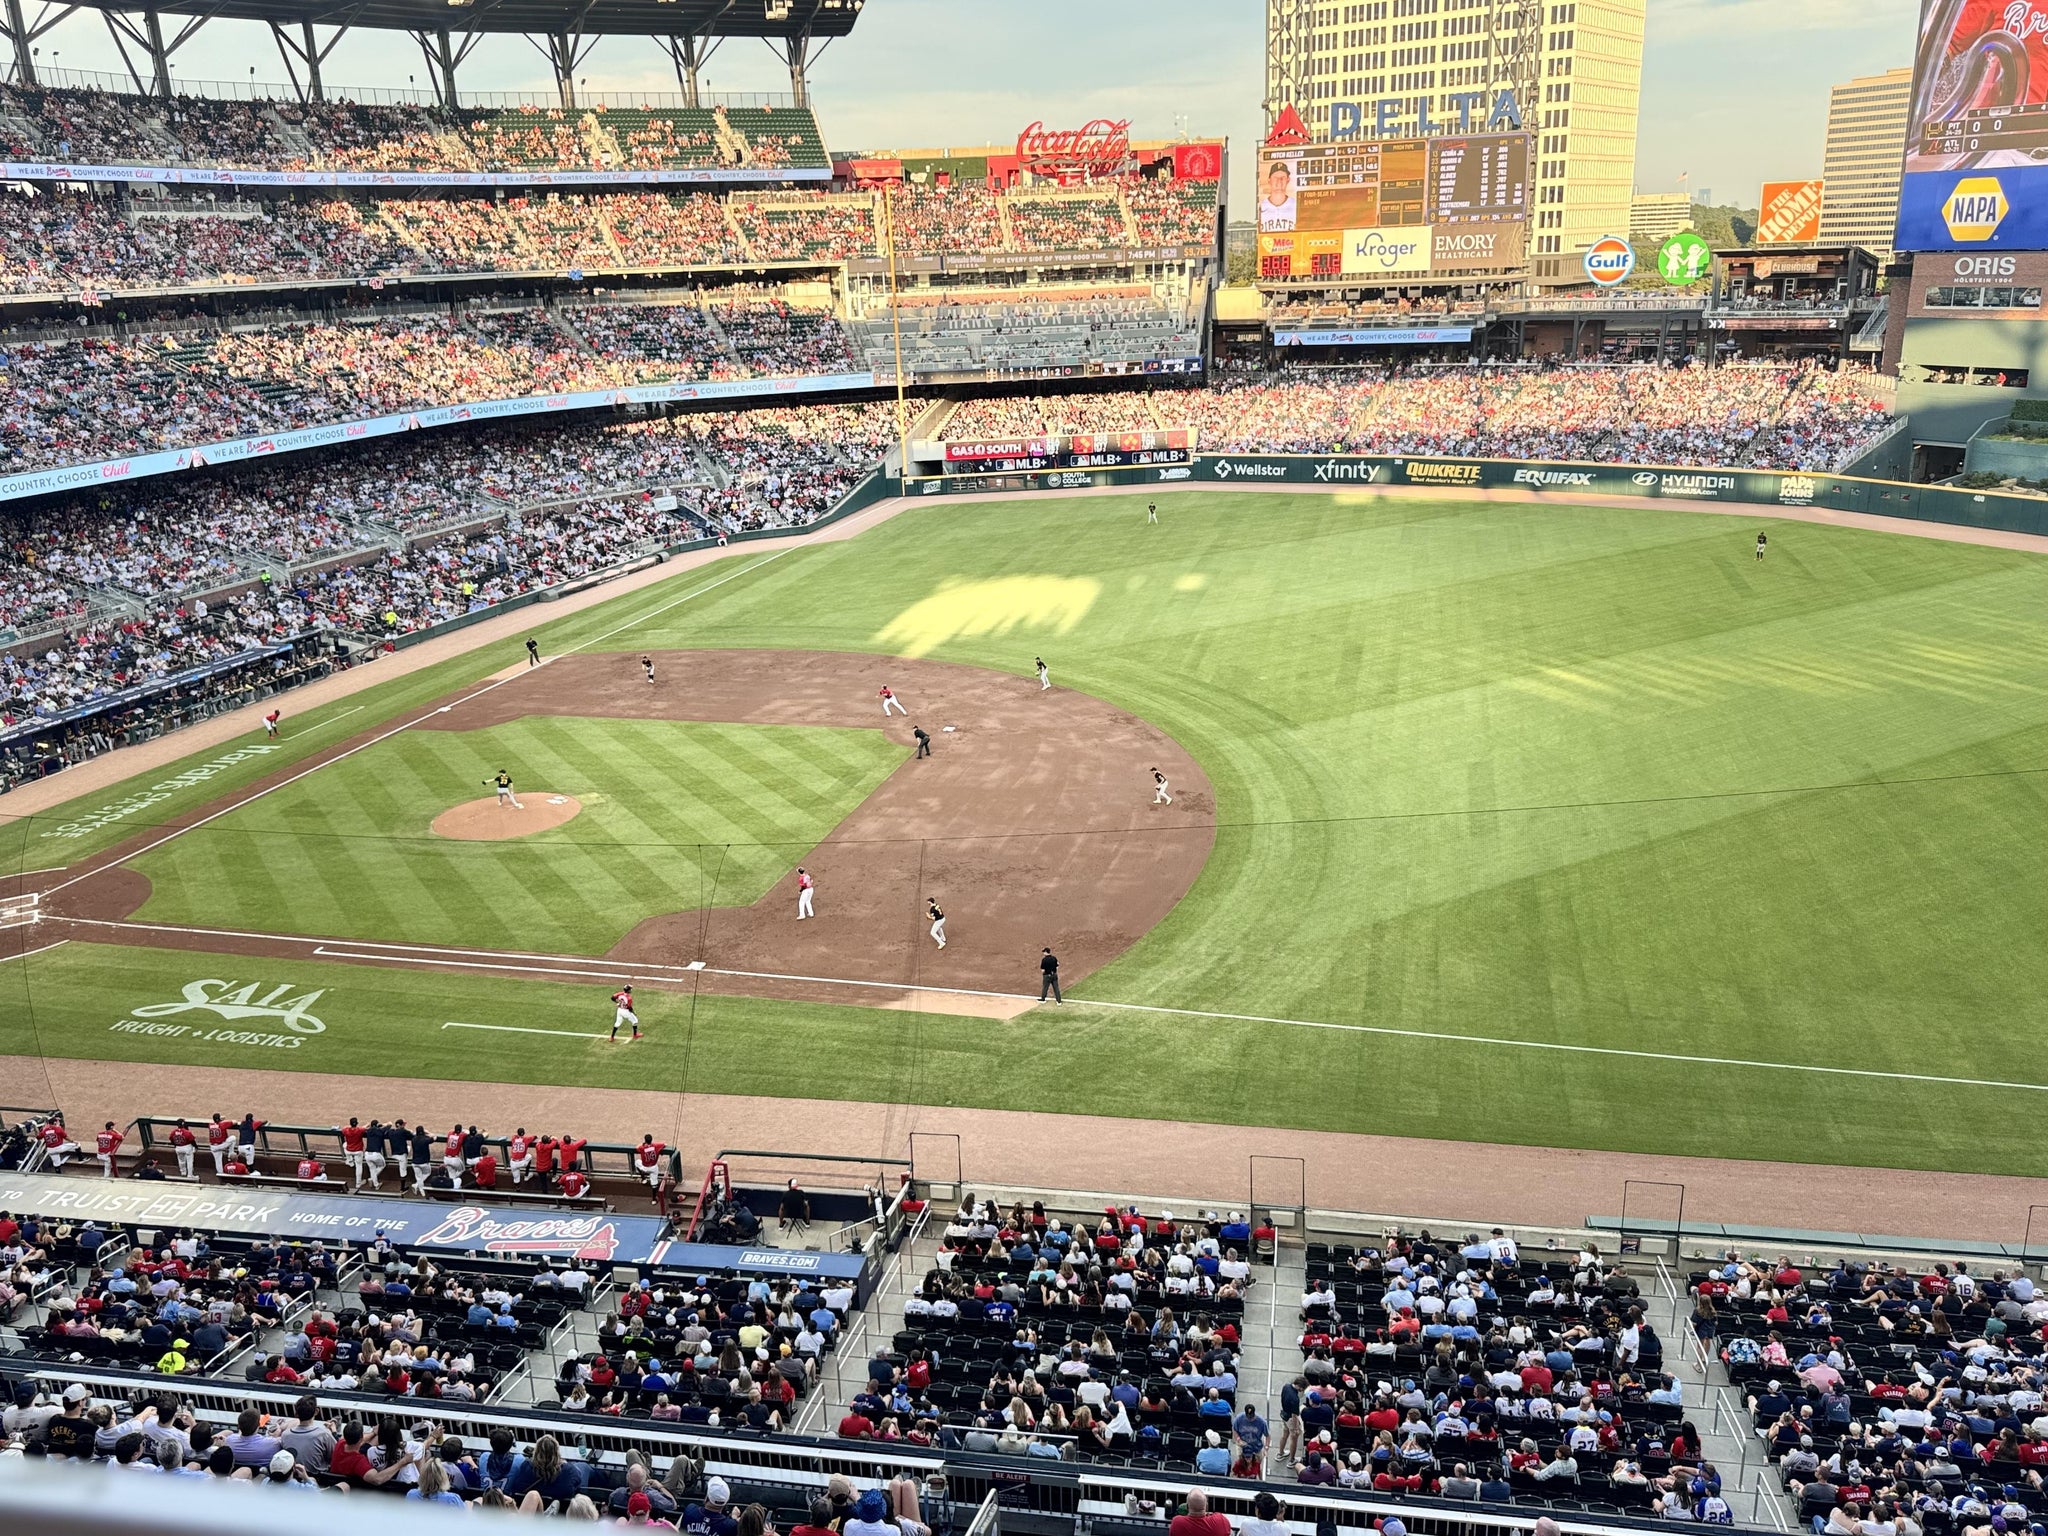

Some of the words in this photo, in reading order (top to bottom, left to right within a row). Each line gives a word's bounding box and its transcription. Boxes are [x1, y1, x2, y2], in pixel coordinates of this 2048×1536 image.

[1330, 90, 1522, 137] DELTA
[1972, 121, 1980, 132] 0
[1994, 120, 2001, 131] 0
[1016, 119, 1133, 163] Coca-Cola
[1970, 139, 1978, 149] 0
[135, 170, 153, 178] Chill
[287, 174, 306, 183] Chill
[453, 175, 470, 183] Chill
[612, 173, 630, 181] Chill
[1766, 188, 1793, 213] THE
[1759, 181, 1822, 241] HOME
[1952, 196, 1997, 223] NAPA
[1781, 202, 1820, 241] DEPOT
[1435, 233, 1498, 251] EMORY
[1356, 232, 1417, 267] Kroger
[1435, 250, 1494, 260] HEALTHCARE
[1072, 253, 1090, 261] GOOD
[1262, 256, 1290, 269] 368
[1588, 254, 1629, 268] Gulf
[1772, 263, 1816, 272] CLUBHOUSE
[1954, 256, 2017, 275] ORIS
[1417, 332, 1437, 340] Chill
[637, 391, 649, 399] WE
[651, 389, 666, 397] ARE
[700, 385, 739, 395] COUNTRY,
[741, 383, 772, 391] CHOOSE
[774, 381, 797, 390] Chill
[426, 414, 436, 422] WE
[436, 412, 448, 420] ARE
[472, 403, 511, 414] COUNTRY,
[512, 401, 544, 409] CHOOSE
[546, 398, 568, 407] Chill
[213, 449, 227, 458] WE
[228, 446, 244, 456] ARE
[277, 434, 314, 447] COUNTRY,
[315, 429, 345, 440] CHOOSE
[346, 424, 367, 436] Chill
[1029, 442, 1044, 452] AL
[951, 446, 974, 456] GAS
[986, 443, 1021, 454] SOUTH
[1153, 450, 1185, 462] MLB+
[1016, 458, 1047, 469] MLB+
[1091, 454, 1122, 465] MLB+
[1062, 471, 1085, 479] SOUTH
[1234, 464, 1287, 477] Wellstar
[1314, 459, 1380, 482] xfinity
[1406, 462, 1481, 479] QUIKRETE
[2, 478, 55, 493] COUNTRY,
[57, 470, 99, 484] CHOOSE
[102, 462, 130, 478] Chill
[1062, 476, 1091, 484] COLLEGE
[1513, 469, 1592, 487] EQUIFAX
[1661, 474, 1735, 490] HYUNDAI
[1781, 476, 1813, 489] PAPA
[1661, 487, 1717, 496] HyundaiUSA.com
[1779, 487, 1814, 498] JOHNS
[1973, 494, 1985, 502] 400
[64, 792, 173, 838] CHEROKEE
[131, 978, 327, 1034] SAIA
[108, 1020, 191, 1037] FREIGHT
[203, 1029, 307, 1049] LOGISTICS
[1, 1190, 23, 1201] TO
[36, 1189, 152, 1214] TRUIST
[189, 1202, 279, 1224] PARK
[289, 1212, 341, 1226] HOME
[344, 1215, 370, 1227] OF
[373, 1218, 409, 1231] THE
[414, 1205, 603, 1246] Braves
[1498, 1247, 1511, 1257] 10
[743, 1253, 817, 1269] BRAVES.COM
[1958, 1284, 1971, 1294] 16
[209, 1312, 222, 1324] 13
[51, 1424, 77, 1440] SKENES
[1578, 1441, 1595, 1451] 27
[1709, 1511, 1726, 1523] 28
[687, 1519, 711, 1534] ACUÑA
